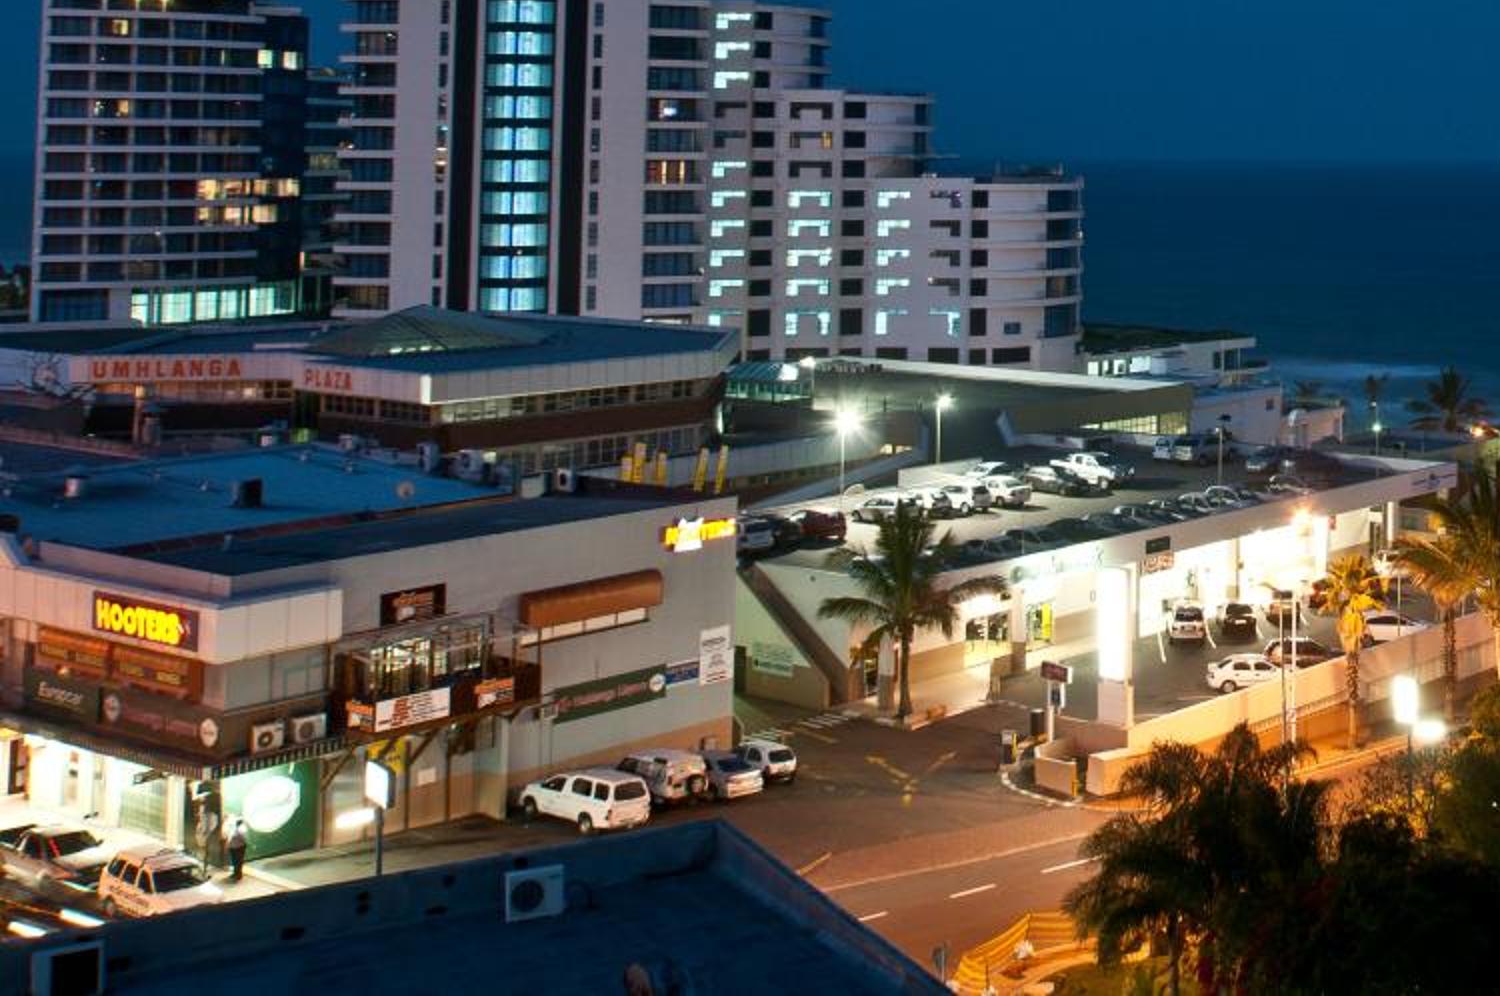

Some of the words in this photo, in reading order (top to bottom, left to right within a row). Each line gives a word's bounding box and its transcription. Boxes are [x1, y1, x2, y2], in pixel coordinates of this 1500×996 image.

[92, 358, 241, 379] UMHLANGA
[303, 367, 353, 389] PLAZA
[665, 517, 737, 545] HTERS
[96, 598, 181, 645] HOOTERS
